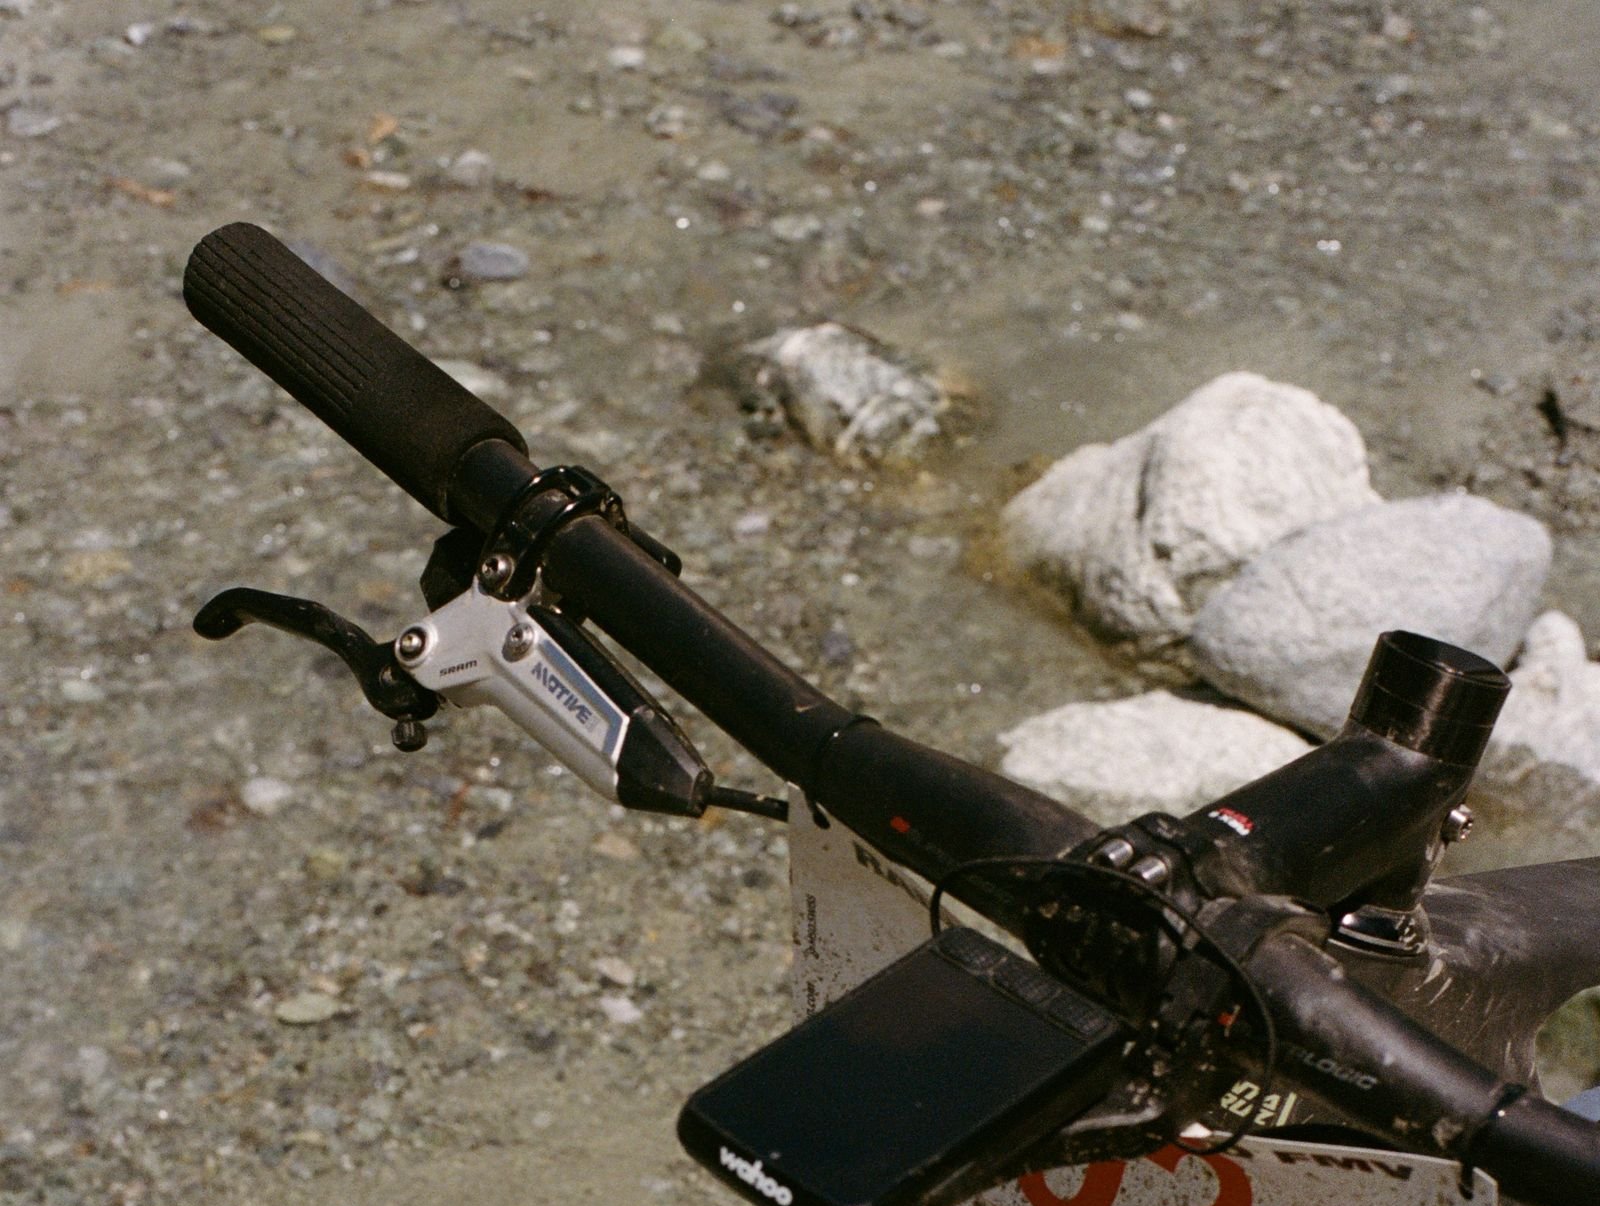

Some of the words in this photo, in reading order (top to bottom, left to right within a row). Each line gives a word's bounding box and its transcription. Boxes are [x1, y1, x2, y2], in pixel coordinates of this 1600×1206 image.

[439, 658, 478, 677] SRAM
[530, 660, 593, 726] MOTIVE
[720, 1147, 792, 1206] wahoo
